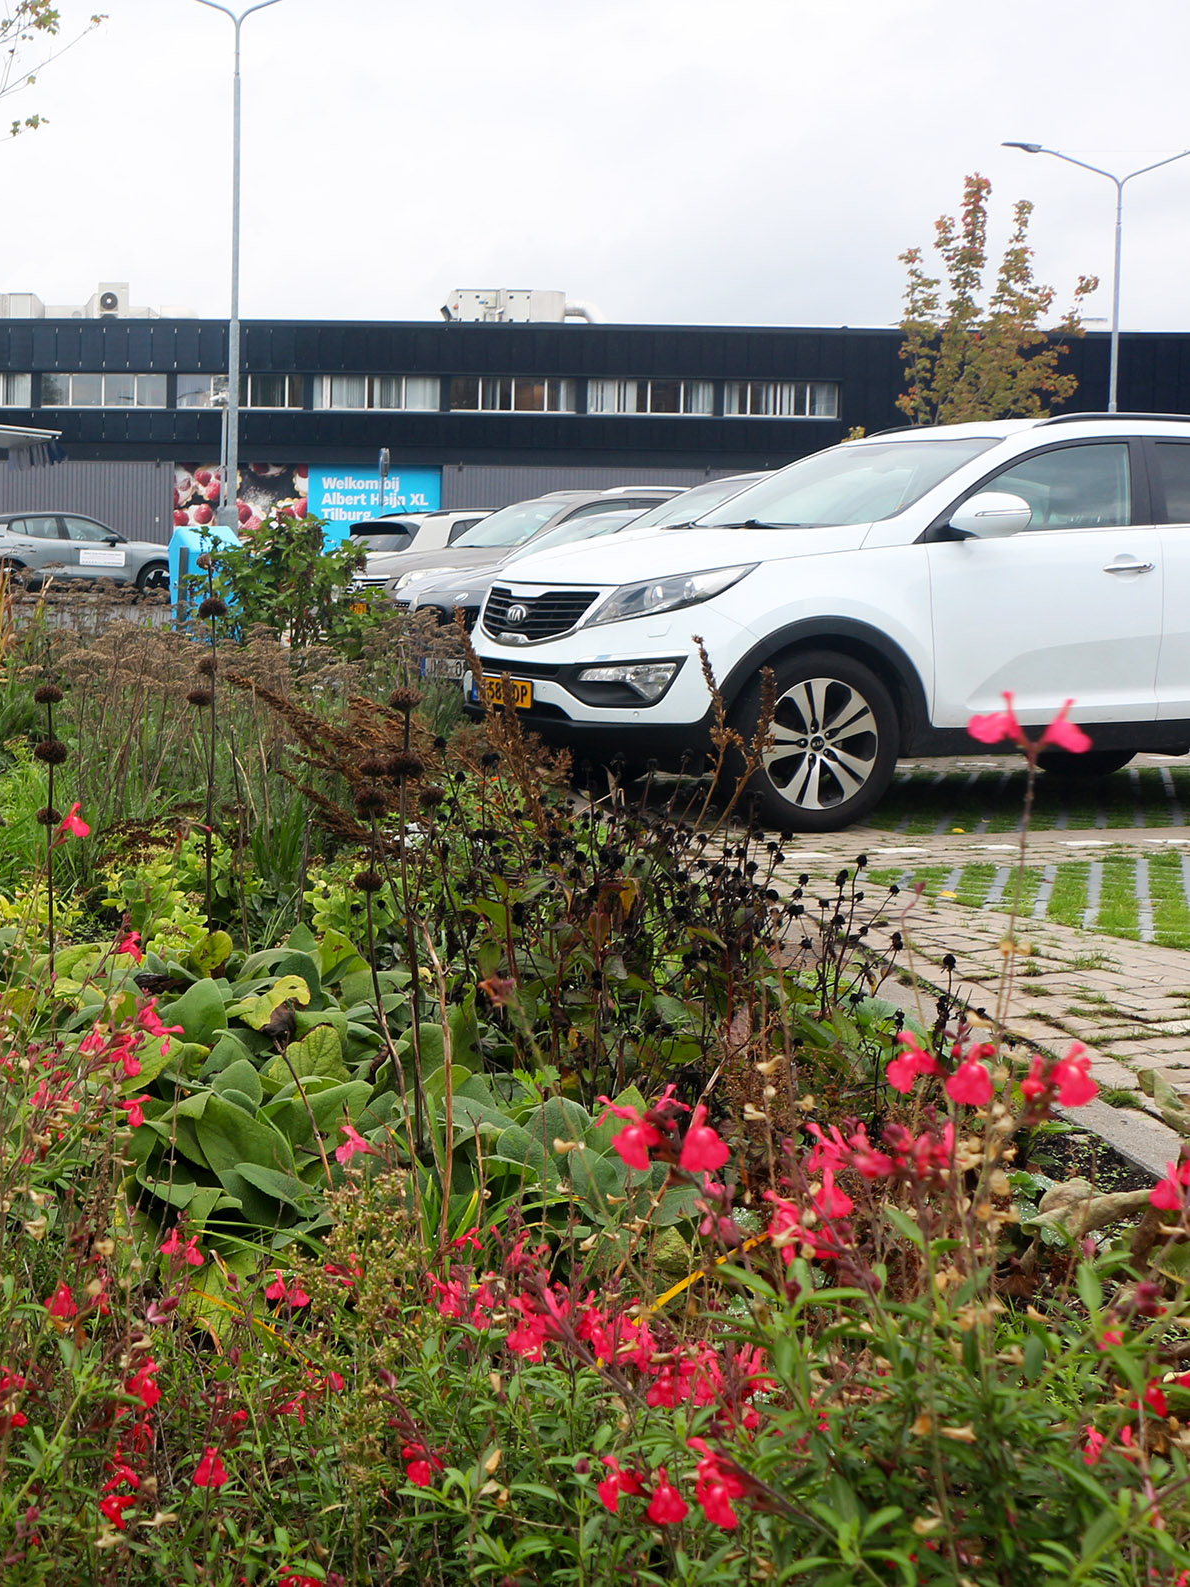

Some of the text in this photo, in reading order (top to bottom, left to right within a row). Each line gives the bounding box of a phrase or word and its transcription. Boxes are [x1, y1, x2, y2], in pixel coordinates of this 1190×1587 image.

[322, 477, 400, 492] Welkom bij
[321, 493, 429, 508] Albert Heijn XL
[509, 608, 522, 621] KIA
